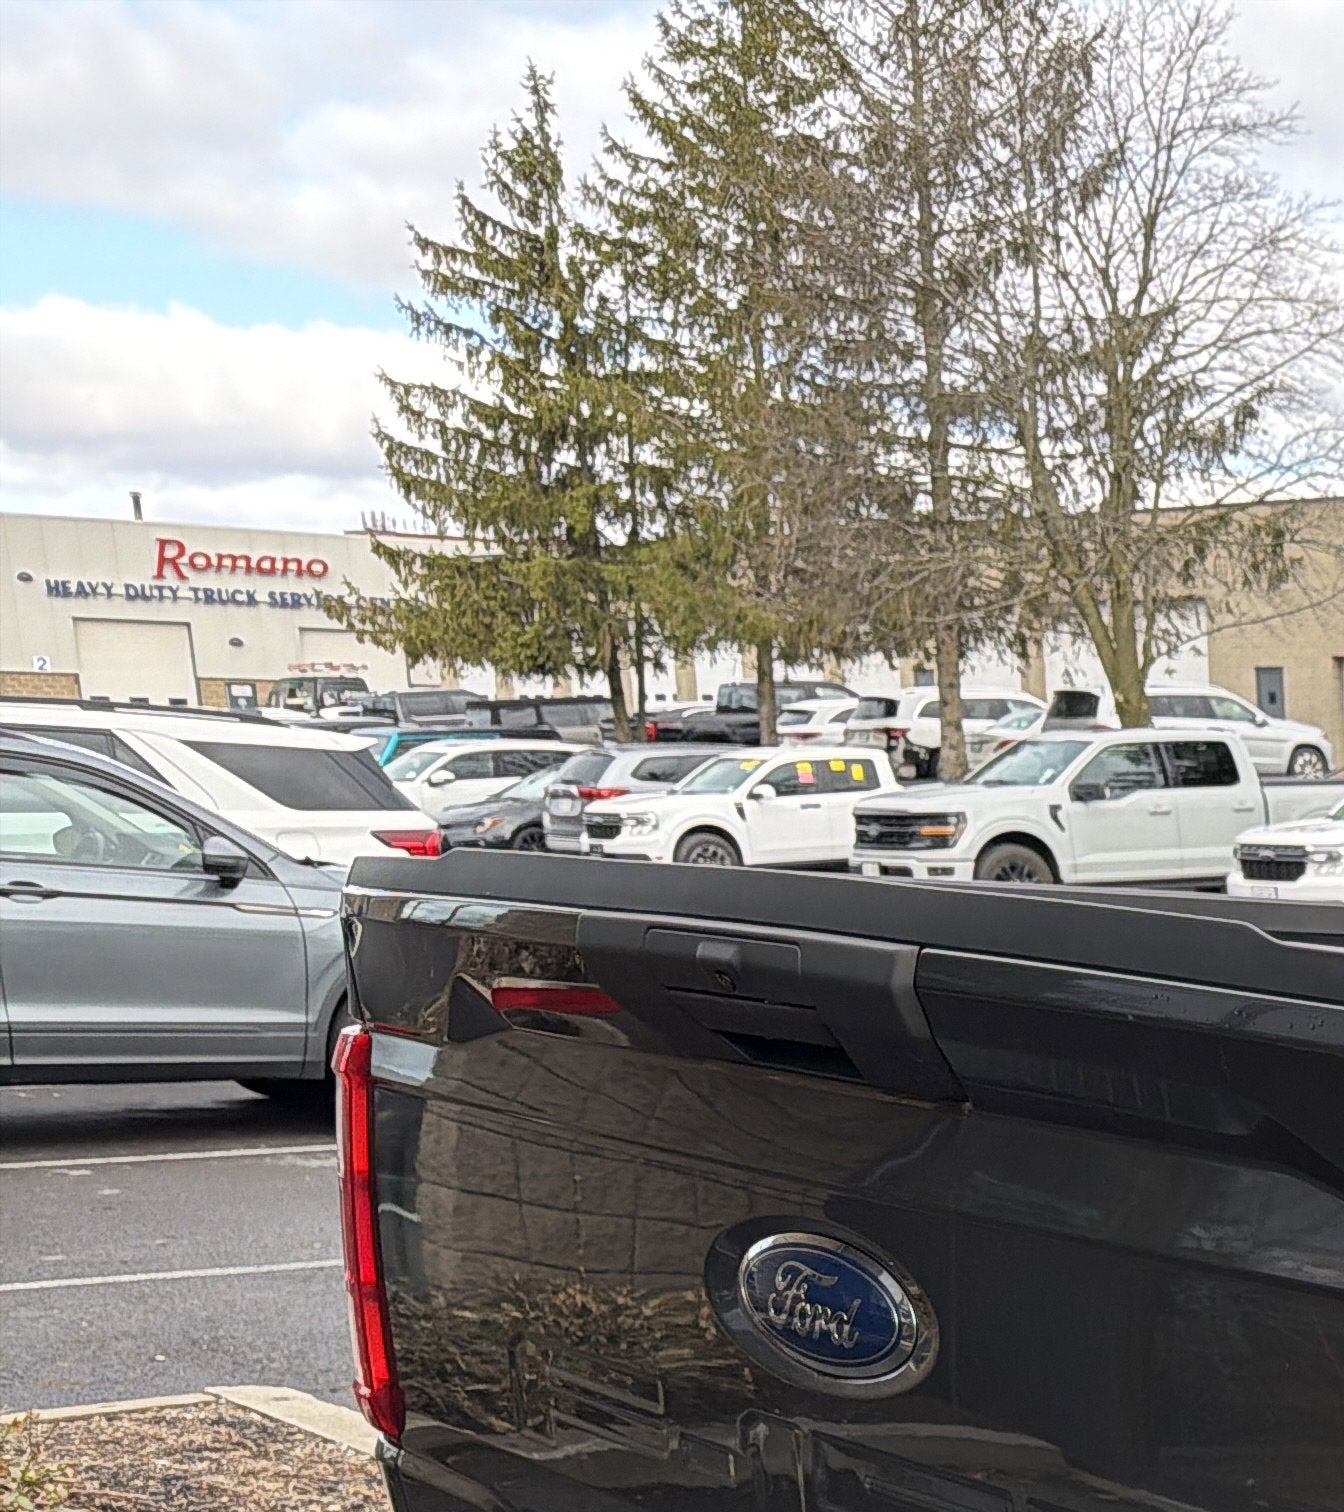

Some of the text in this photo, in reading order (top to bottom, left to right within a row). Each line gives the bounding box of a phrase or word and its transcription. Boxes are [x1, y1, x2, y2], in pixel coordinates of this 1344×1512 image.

[152, 537, 329, 581] Romano
[45, 578, 115, 600] HEAVY
[123, 582, 180, 602] DUTY
[188, 585, 257, 606] TRUCK
[35, 656, 48, 672] 2
[767, 1260, 862, 1349] Ford
